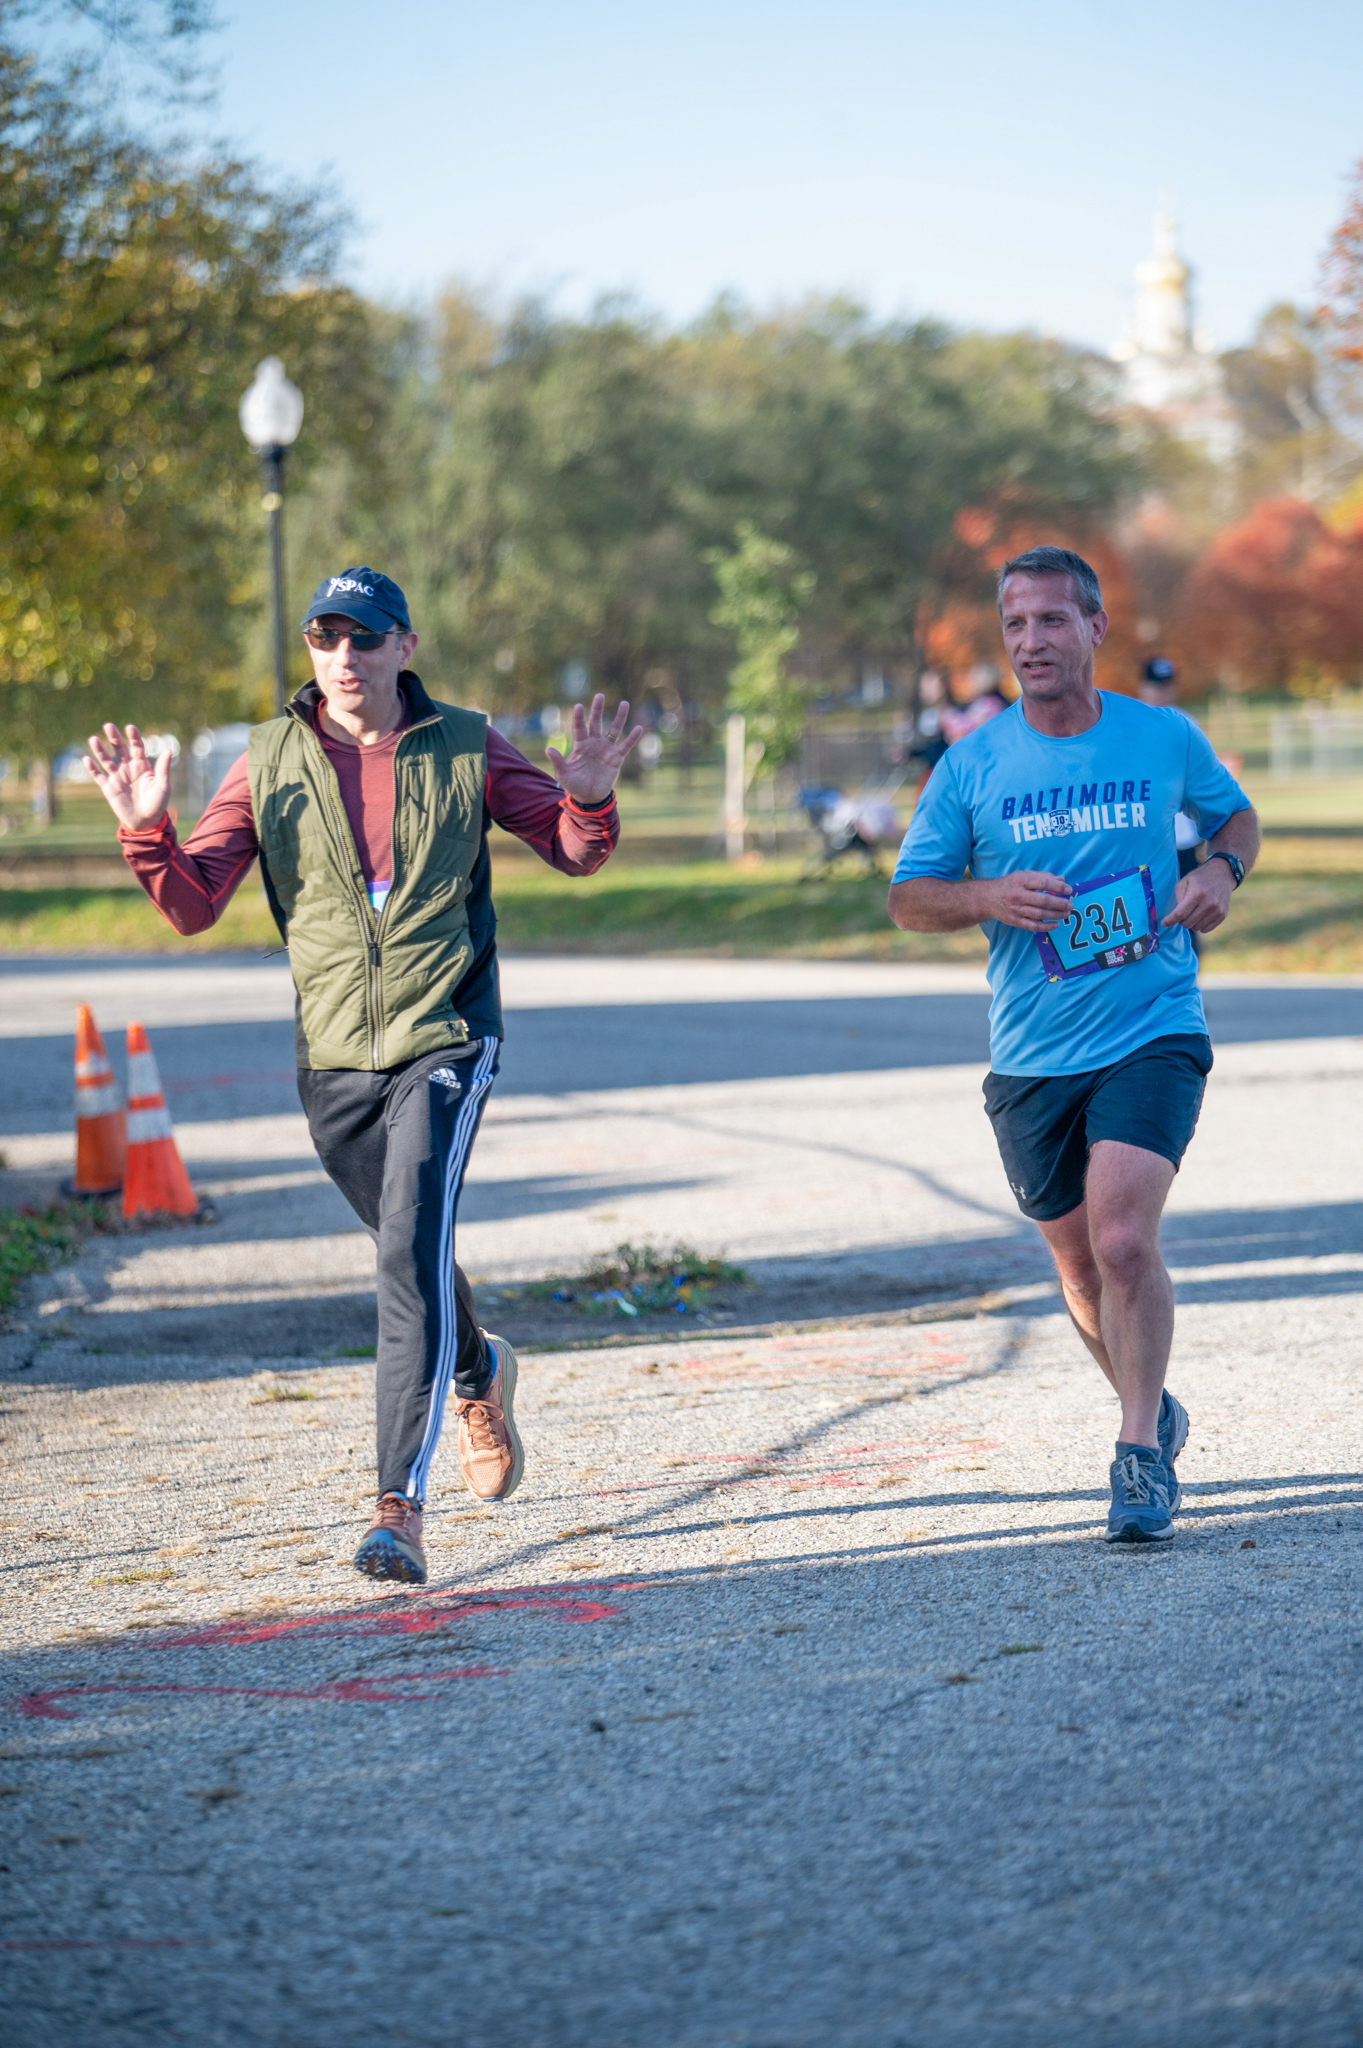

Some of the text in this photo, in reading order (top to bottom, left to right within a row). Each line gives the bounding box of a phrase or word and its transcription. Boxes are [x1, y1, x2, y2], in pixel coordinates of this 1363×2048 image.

[1002, 780, 1151, 820] BALTIMORE
[1008, 802, 1147, 844] TEN MILER
[1055, 815, 1066, 826] 10
[1063, 895, 1134, 952] 234
[1114, 945, 1127, 957] 5K
[429, 1074, 461, 1089] adidas
